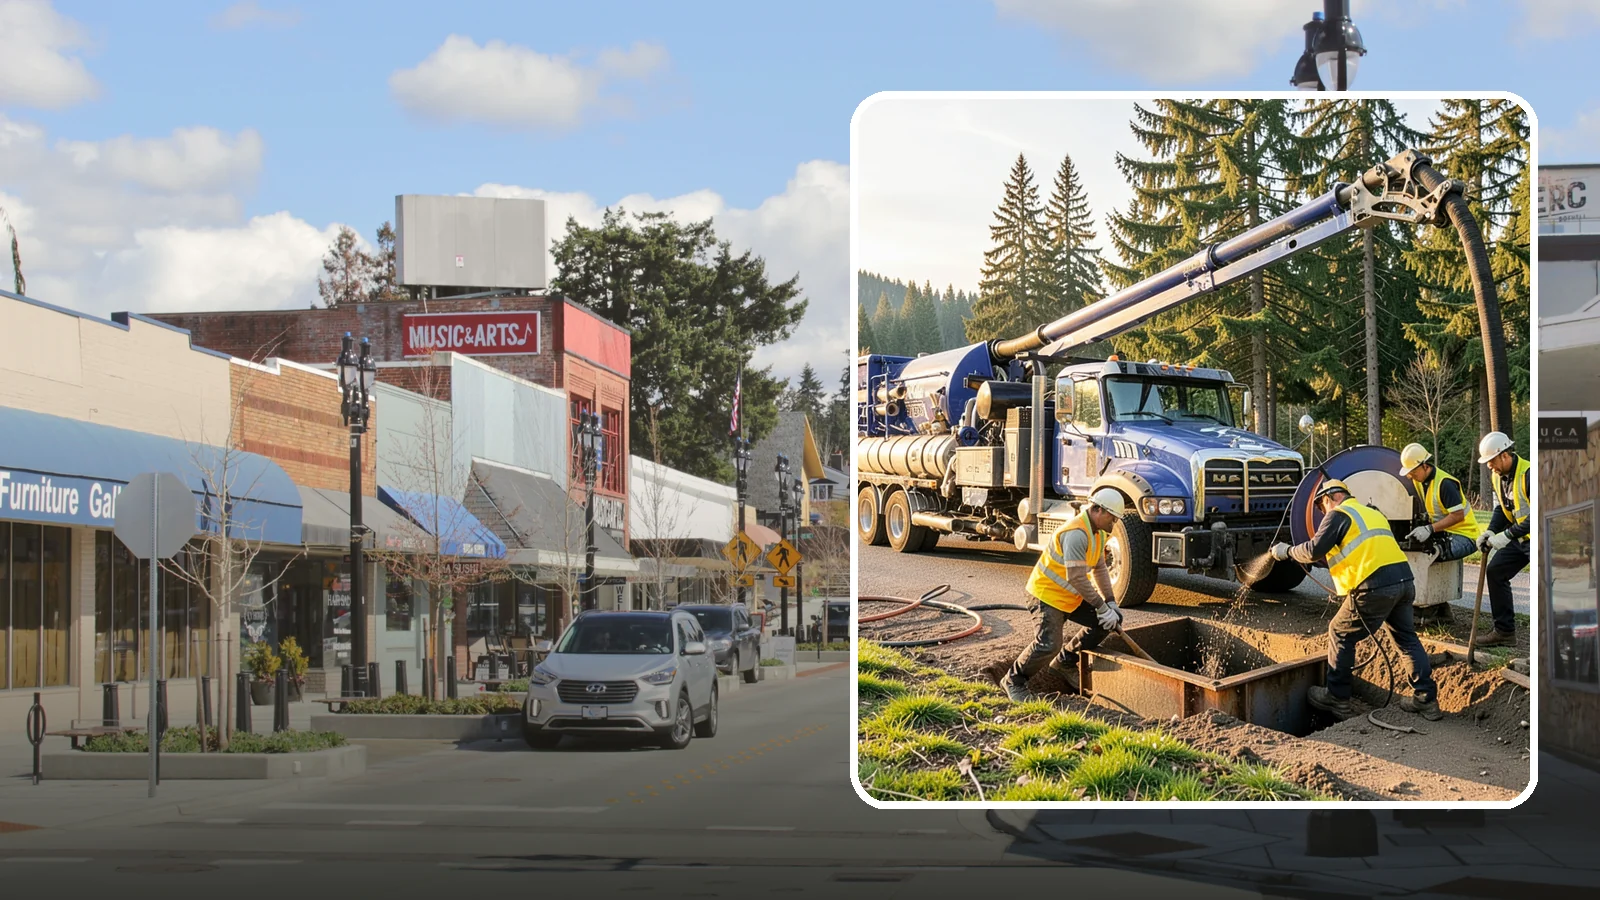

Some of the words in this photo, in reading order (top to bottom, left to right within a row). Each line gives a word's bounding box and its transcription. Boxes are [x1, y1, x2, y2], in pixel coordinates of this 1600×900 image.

[0, 471, 79, 515] Furniture
[89, 482, 121, 519] Gal
[453, 563, 480, 575] SUSHI
